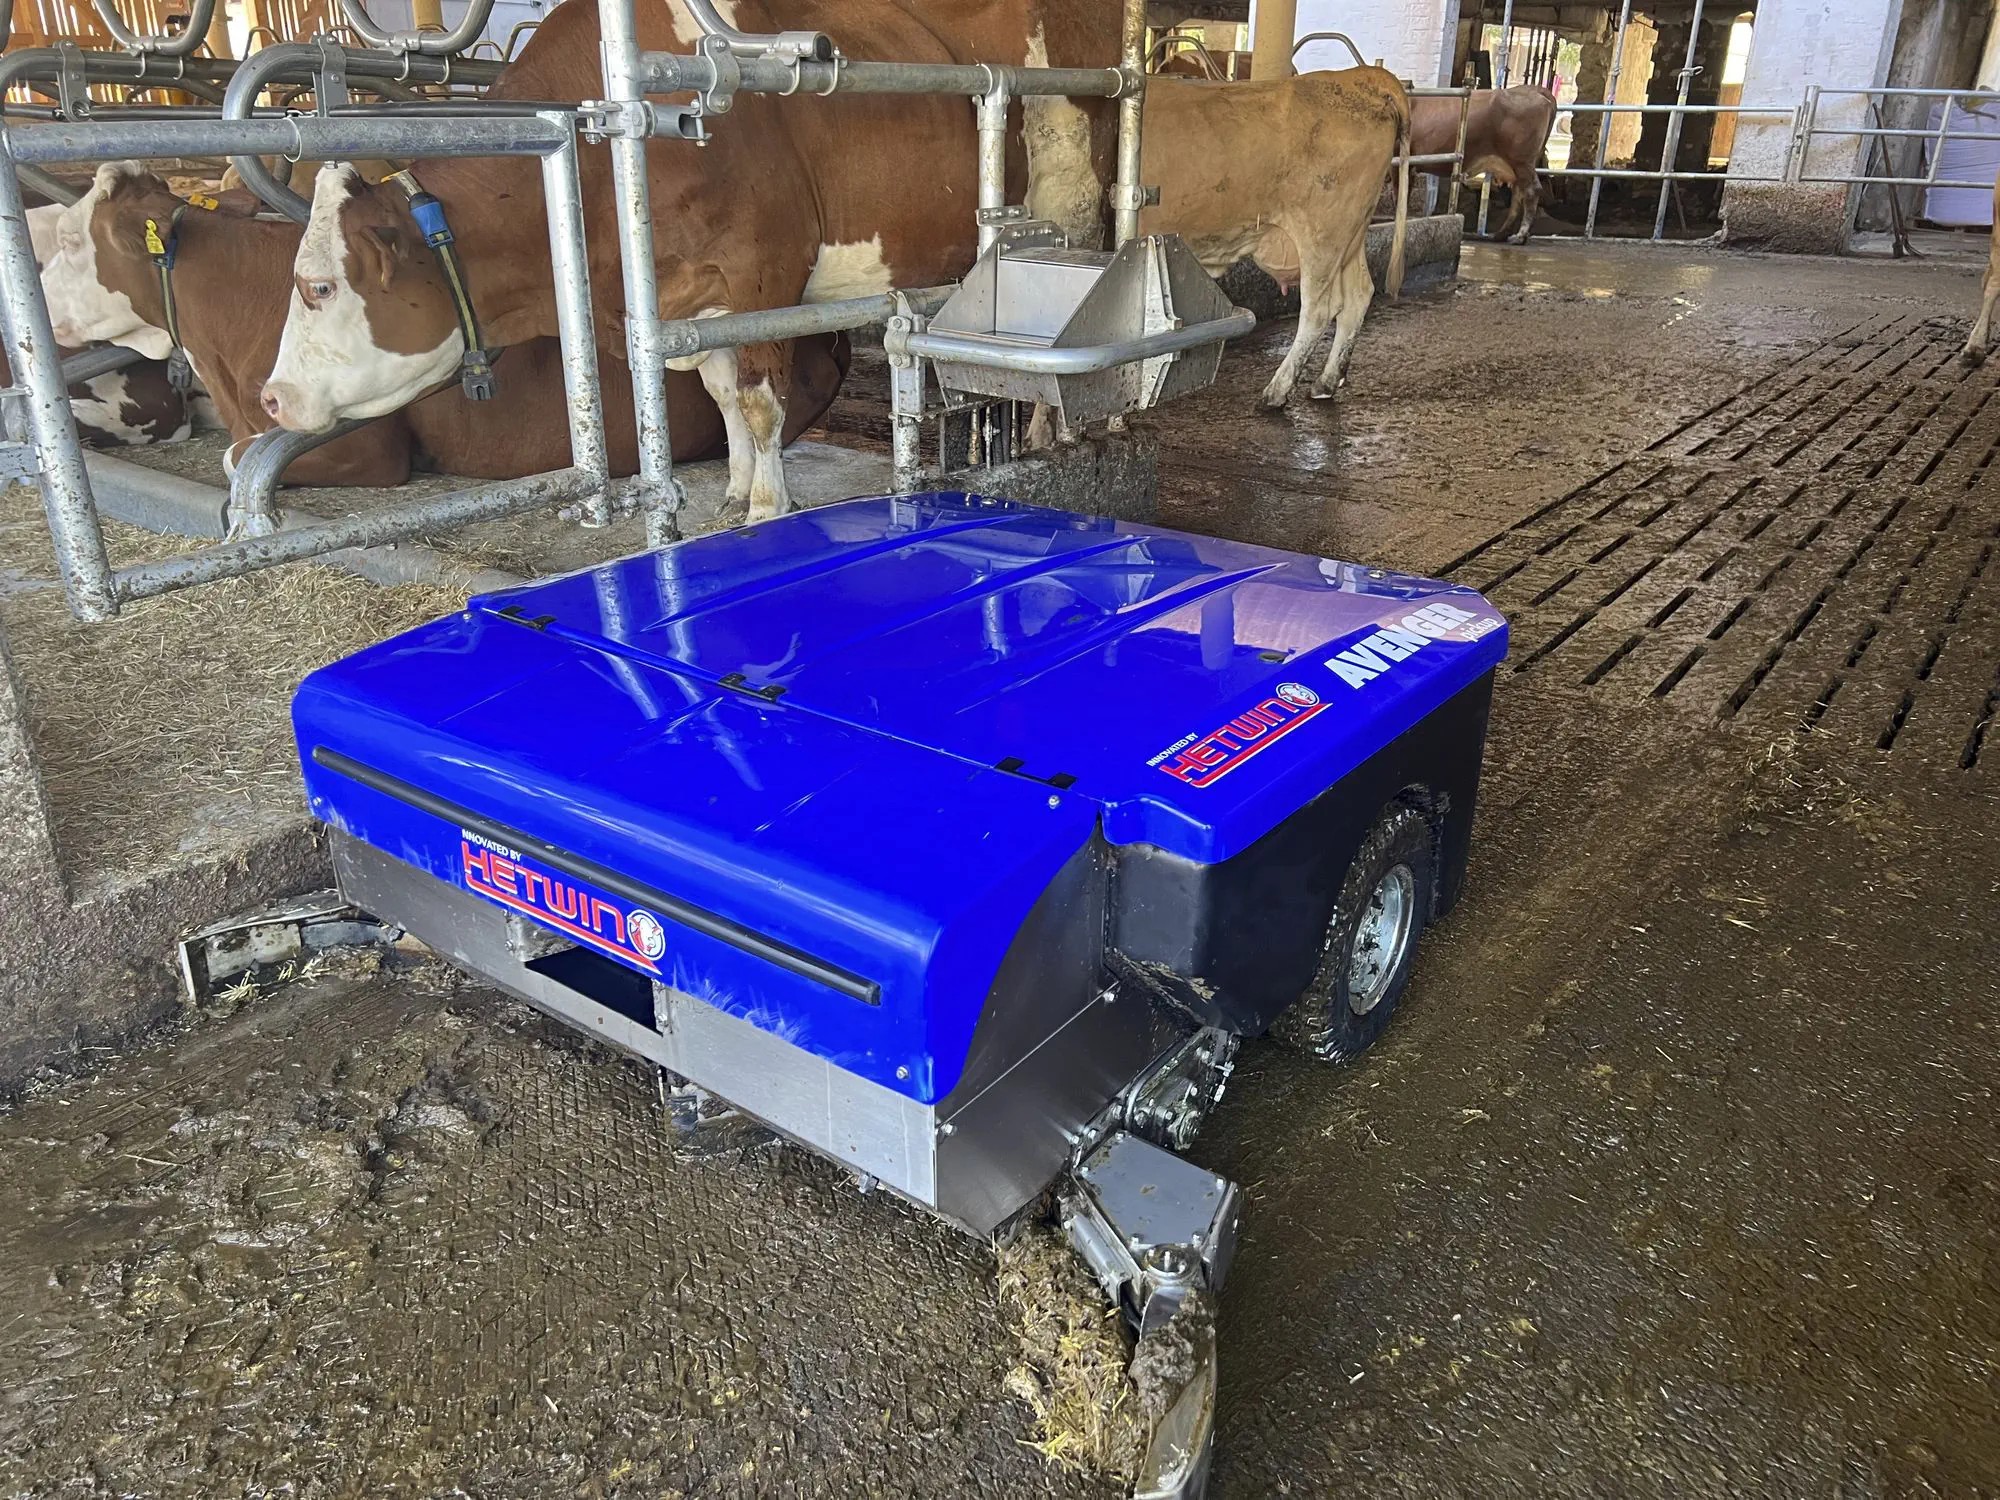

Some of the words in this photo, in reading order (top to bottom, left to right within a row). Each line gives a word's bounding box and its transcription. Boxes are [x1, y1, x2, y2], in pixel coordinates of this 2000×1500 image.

[1323, 602, 1477, 690] AVENGER
[1461, 617, 1501, 643] pickup
[1146, 739, 1189, 767] INNOVATED
[1185, 732, 1199, 742] BY
[1158, 697, 1300, 783] HETWIN
[510, 849, 522, 862] BY
[461, 840, 626, 944] HETWIN
